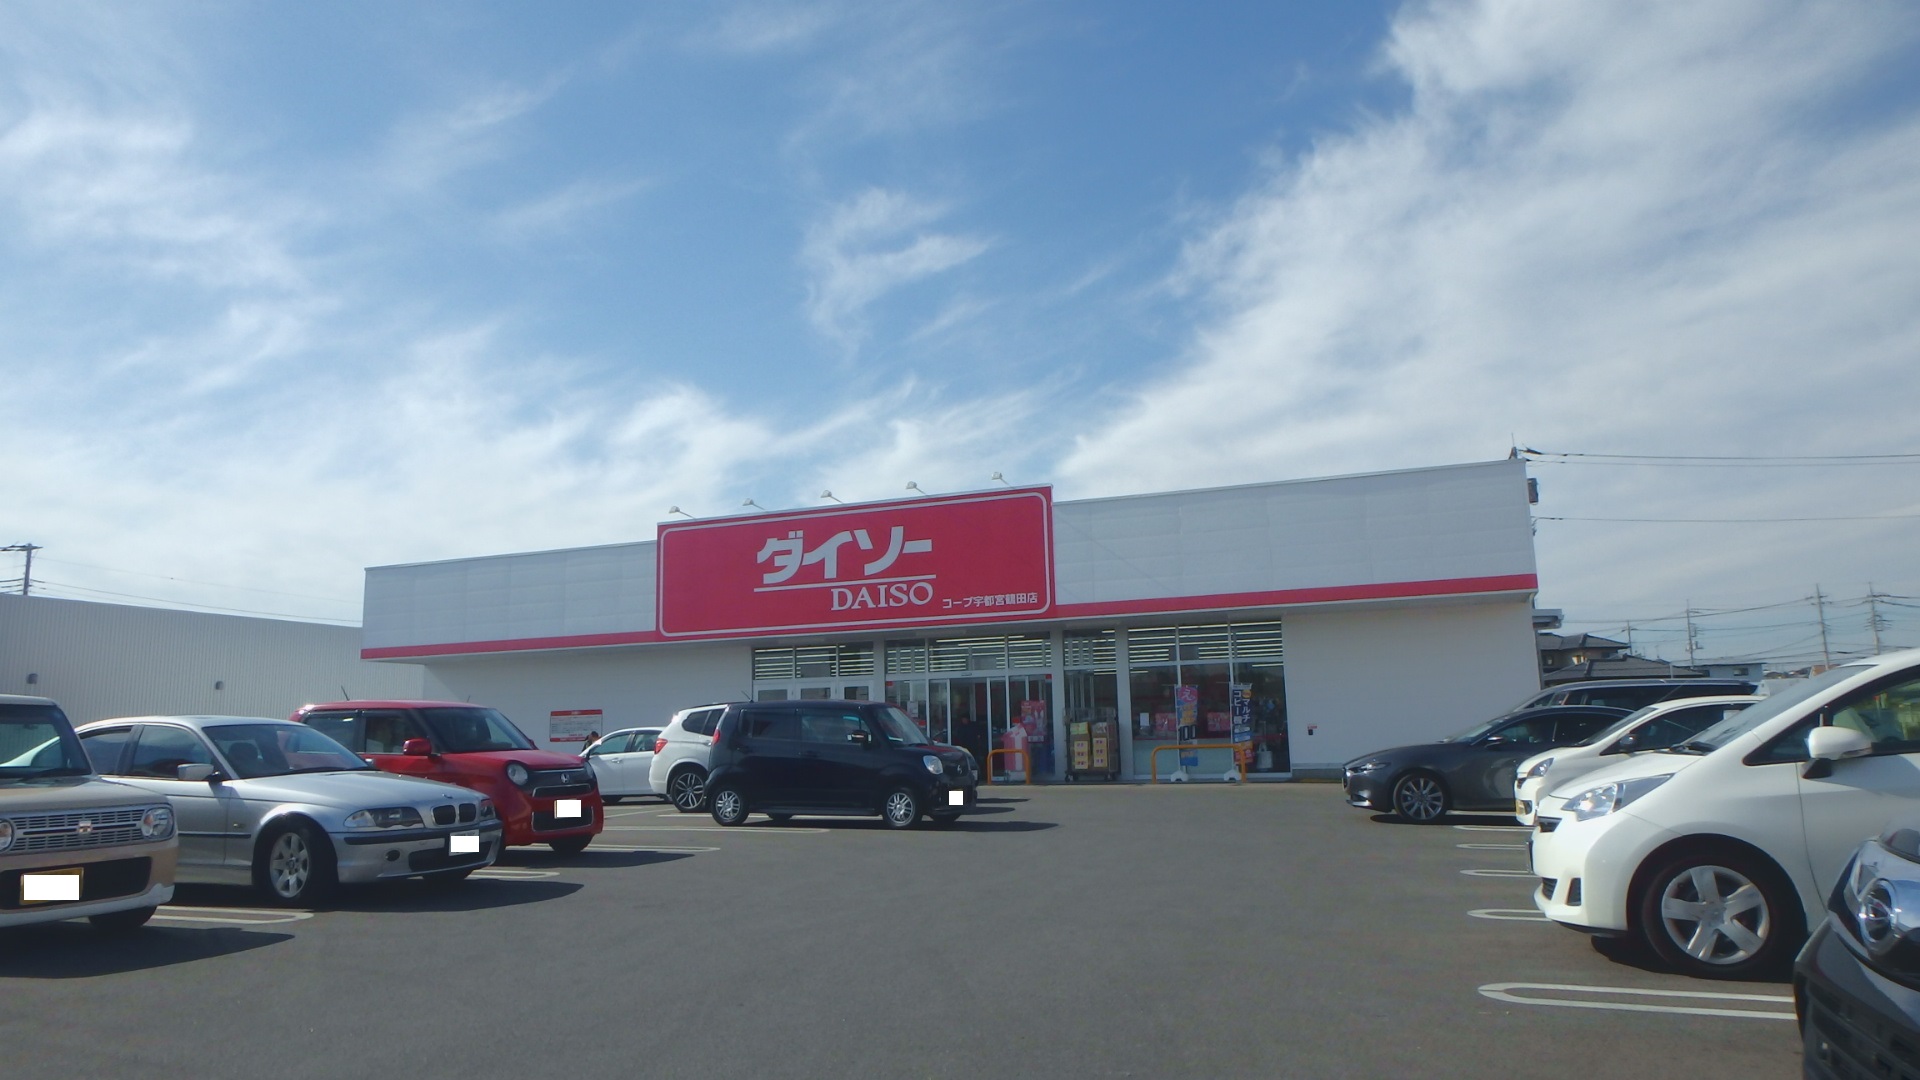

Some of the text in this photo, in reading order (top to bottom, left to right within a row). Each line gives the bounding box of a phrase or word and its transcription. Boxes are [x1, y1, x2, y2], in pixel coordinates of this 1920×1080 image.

[757, 526, 932, 584] ダイソー
[831, 581, 933, 610] DAISO
[942, 592, 1038, 608] コープ宇都宮鶴田店
[1242, 698, 1251, 723] マルチ
